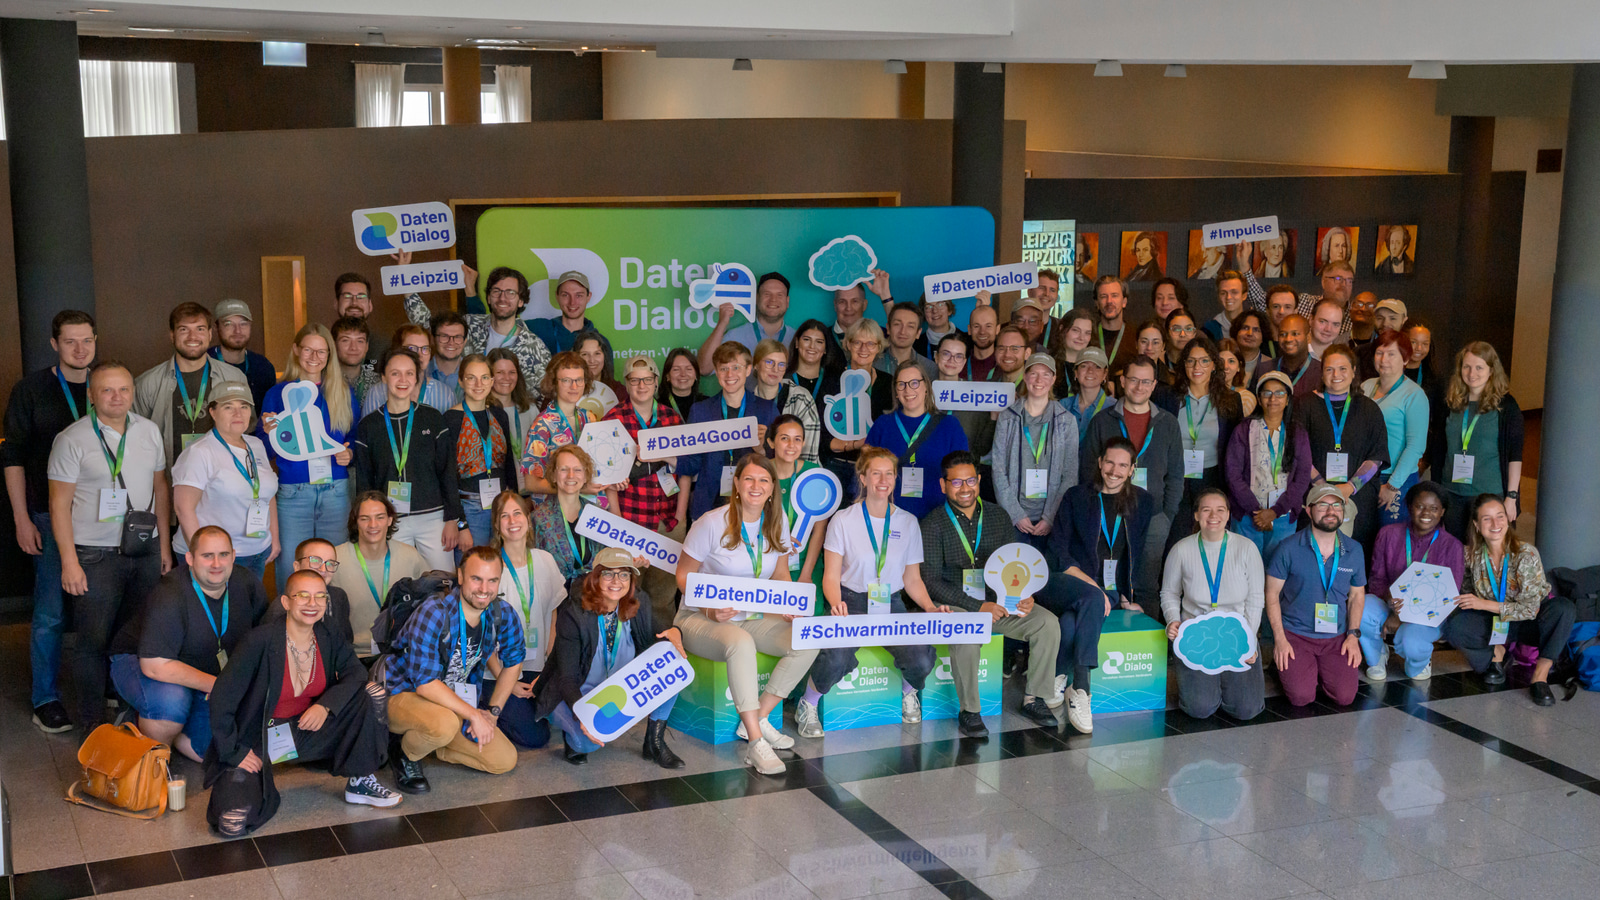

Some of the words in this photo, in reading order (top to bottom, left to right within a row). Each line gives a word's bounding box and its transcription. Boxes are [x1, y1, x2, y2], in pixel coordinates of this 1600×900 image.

[401, 212, 447, 227] Daten
[400, 228, 450, 244] Dialog
[1210, 224, 1272, 240] #Impulse
[390, 269, 458, 287] #Leipzig
[620, 257, 714, 288] Date
[932, 271, 1032, 295] #DatenDialog
[613, 348, 655, 359] netzen
[939, 390, 1008, 408] #Leipzig
[647, 425, 752, 451] #Data4Good
[586, 516, 679, 565] #Data4Goo
[694, 584, 808, 611] #DatenDialog
[800, 620, 985, 640] #Schwarmintelligenz
[1126, 652, 1153, 661] Daten
[624, 650, 676, 690] Daten
[861, 666, 889, 675] Daten
[1124, 662, 1153, 672] Dialog
[632, 665, 688, 708] Dialog
[859, 676, 888, 686] Dialog
